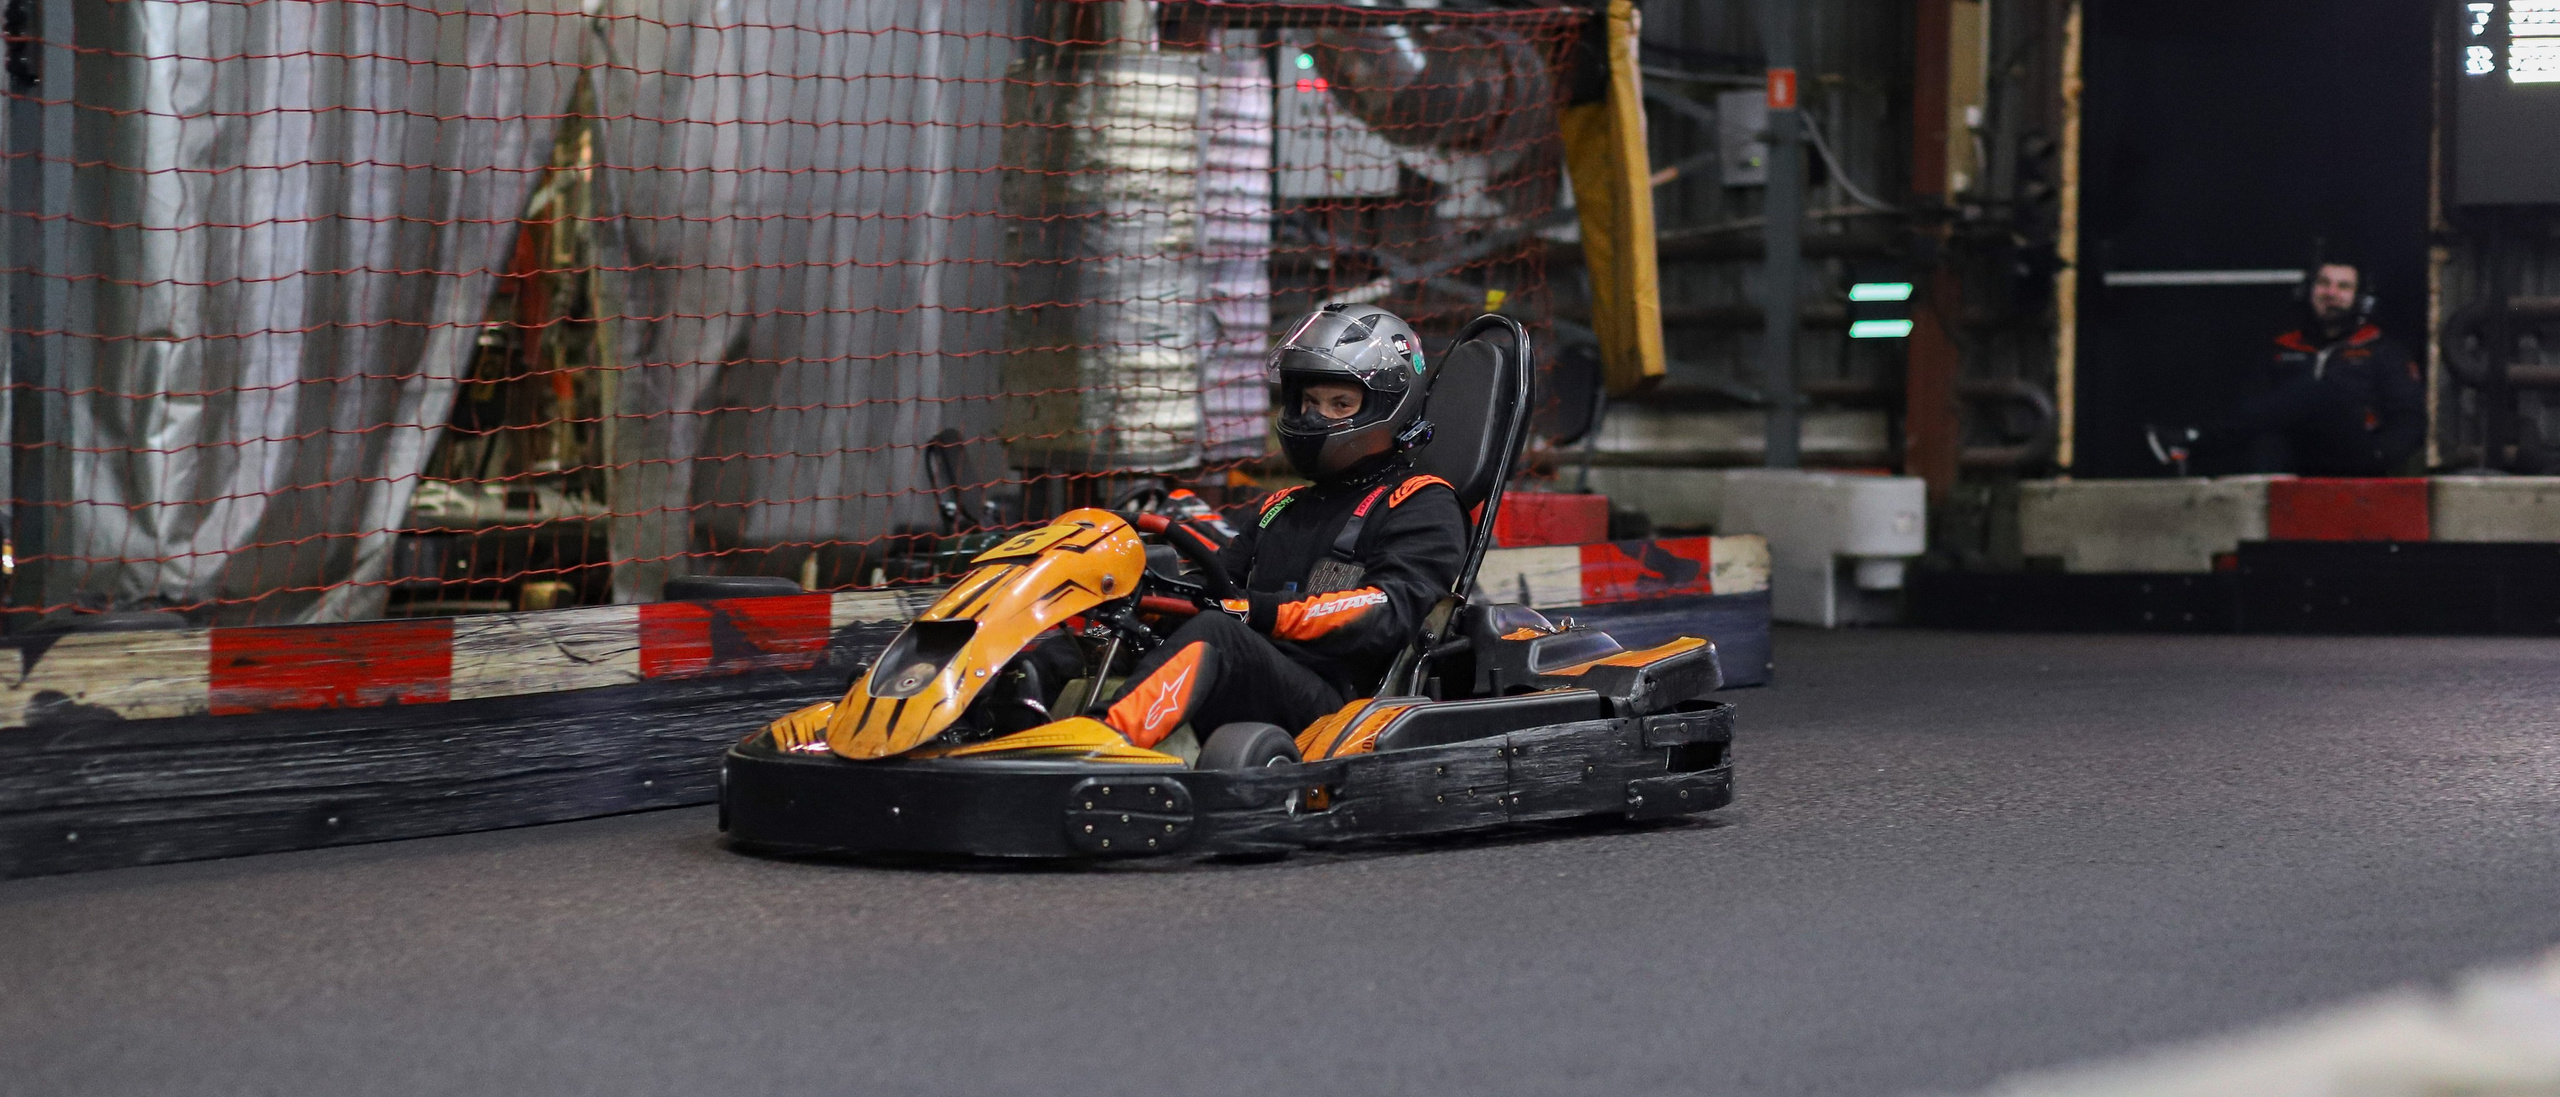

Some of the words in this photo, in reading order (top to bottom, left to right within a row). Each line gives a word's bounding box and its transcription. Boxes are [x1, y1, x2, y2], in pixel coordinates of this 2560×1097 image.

[2467, 2, 2494, 35] 7
[1003, 532, 1047, 552] 5
[1303, 591, 1388, 621] ASTARS
